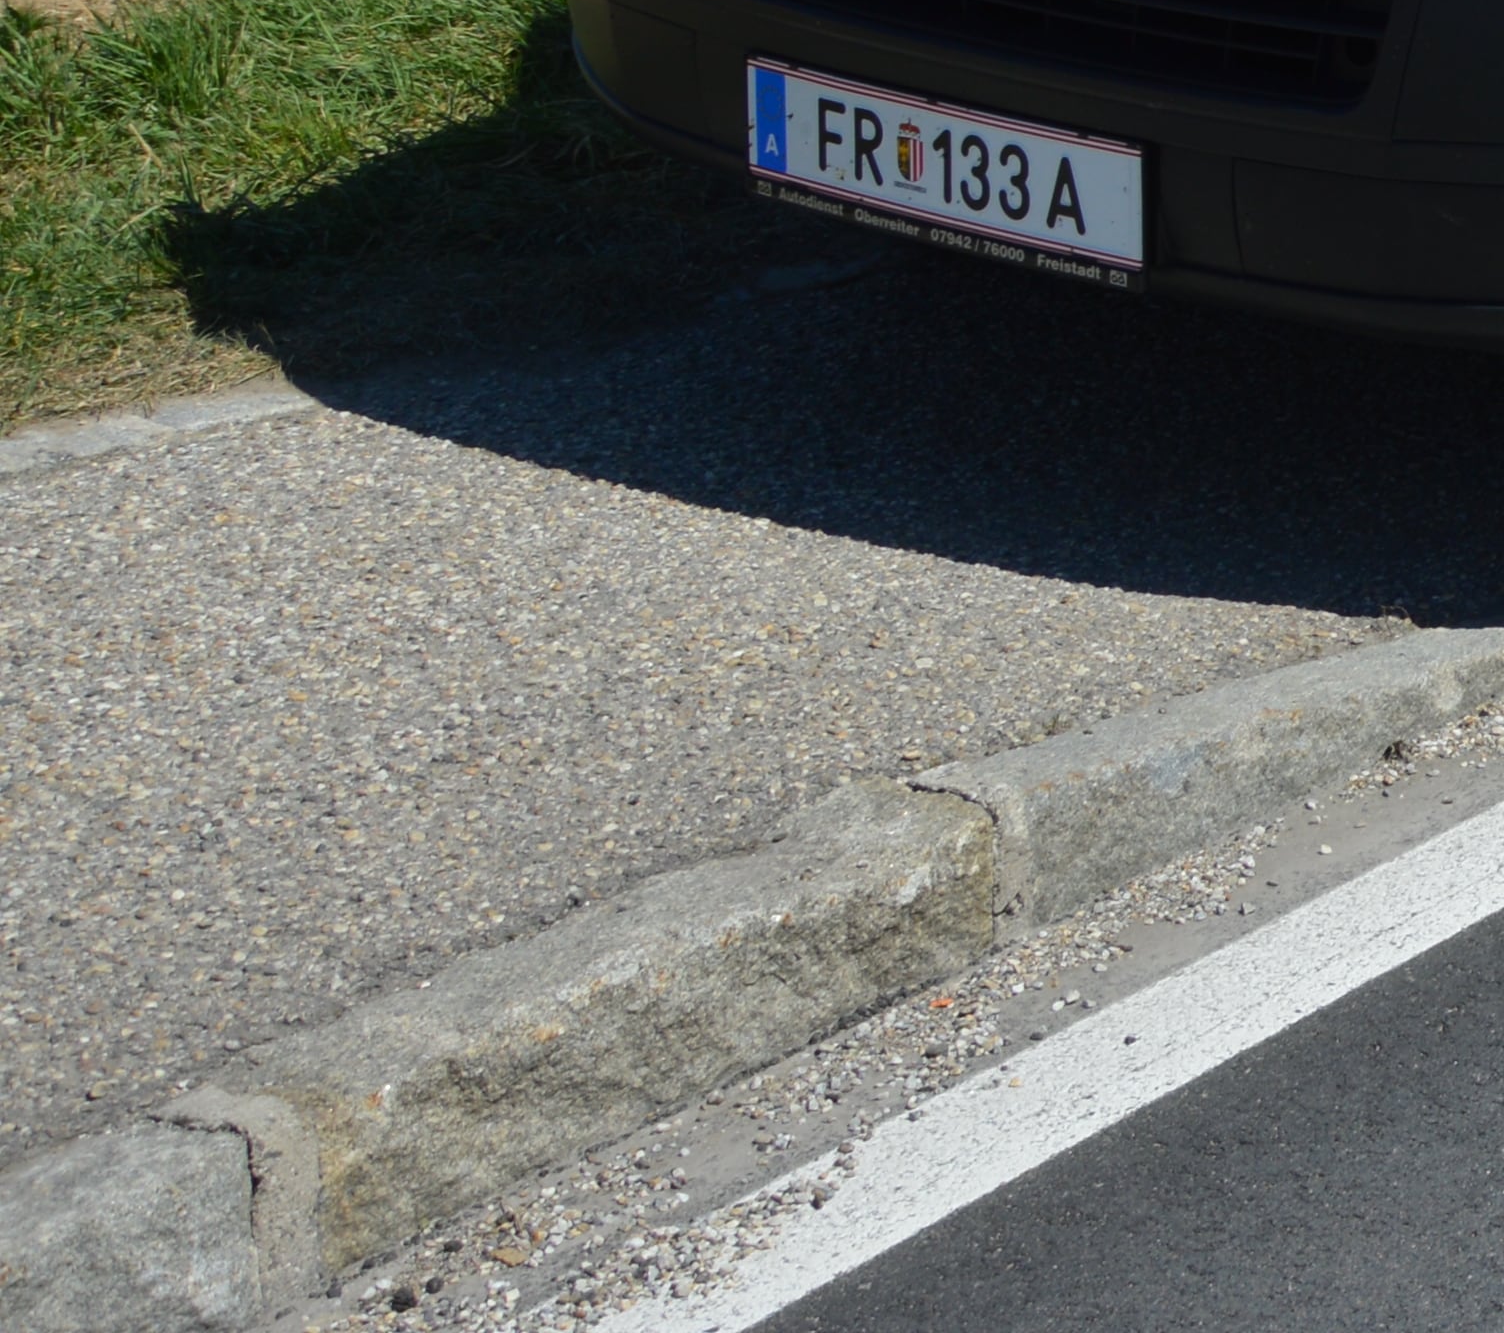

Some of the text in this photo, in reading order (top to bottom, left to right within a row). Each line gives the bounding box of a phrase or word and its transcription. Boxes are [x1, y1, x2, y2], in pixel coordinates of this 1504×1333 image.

[764, 134, 780, 157] A
[817, 96, 884, 186] FR
[778, 187, 845, 218] Autodienst
[854, 209, 920, 237] Oberreiter
[1037, 253, 1103, 281] Freistadt
